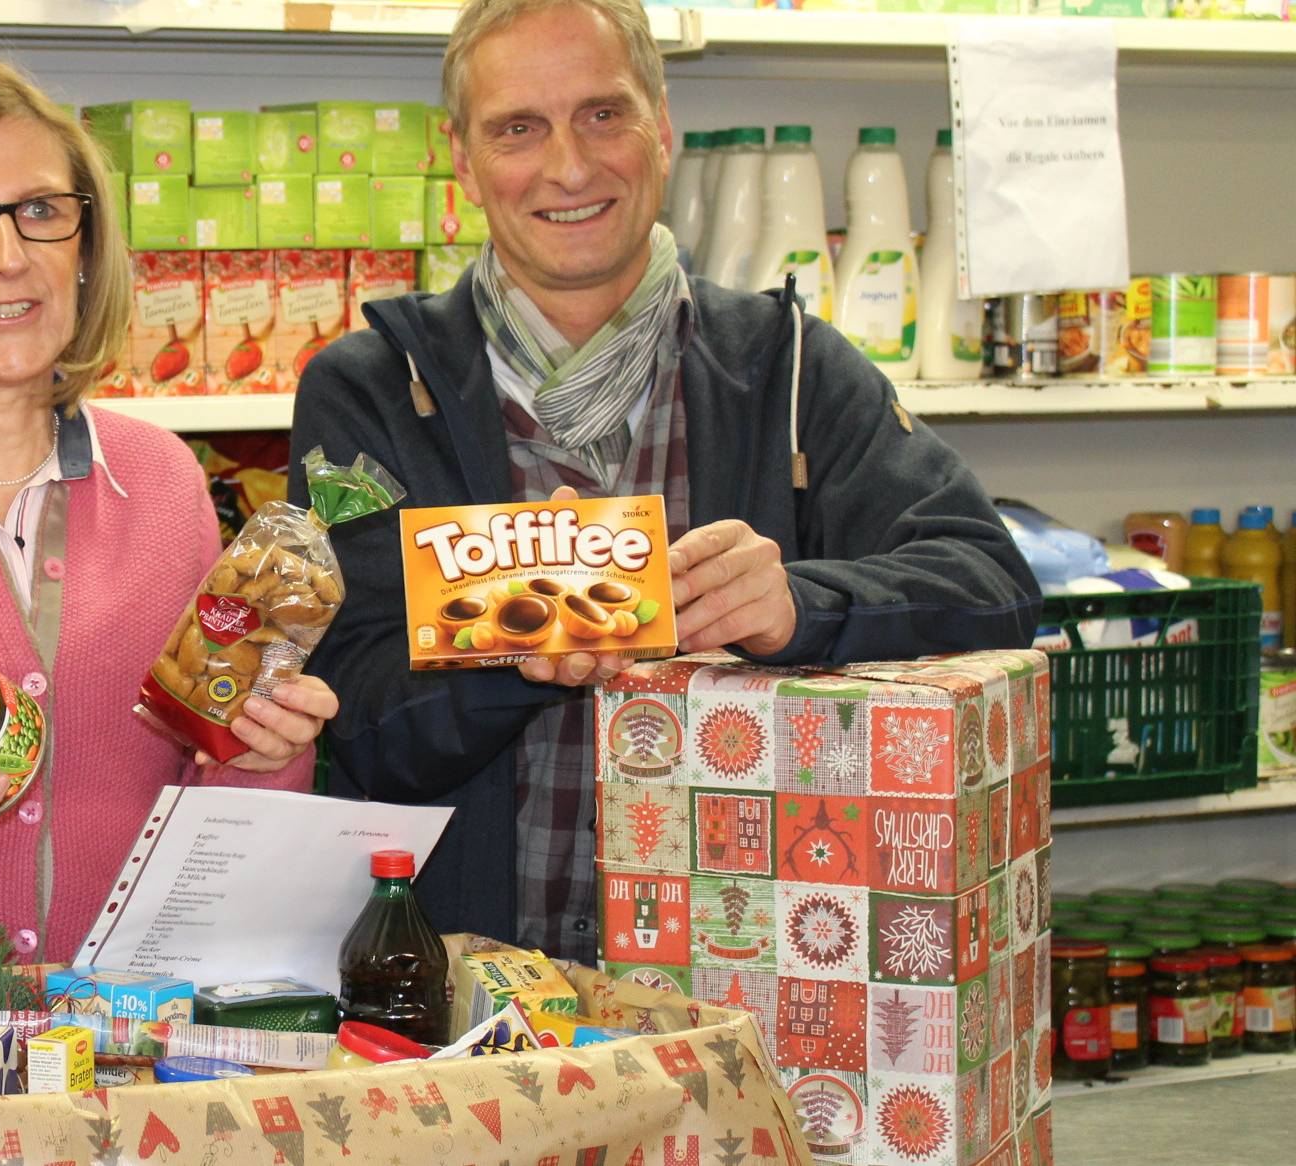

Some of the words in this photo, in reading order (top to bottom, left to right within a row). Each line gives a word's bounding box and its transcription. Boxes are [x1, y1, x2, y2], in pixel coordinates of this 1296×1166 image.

[621, 509, 650, 518] STORCK
[414, 508, 653, 583] Toffifee
[440, 587, 453, 596] Die
[453, 577, 488, 592] Haselnuss
[488, 574, 496, 583] in
[497, 571, 527, 581] Caramel
[527, 569, 540, 577] mit
[541, 568, 589, 578] Nougatcreme
[590, 569, 604, 577] und
[605, 571, 646, 585] Schokolade
[207, 706, 229, 720] 150g
[874, 808, 954, 849] CHRISTMAS
[887, 850, 938, 890] MERRY
[115, 994, 148, 1013] +10%
[116, 1011, 146, 1020] GRATIS
[70, 1067, 93, 1088] Braten
